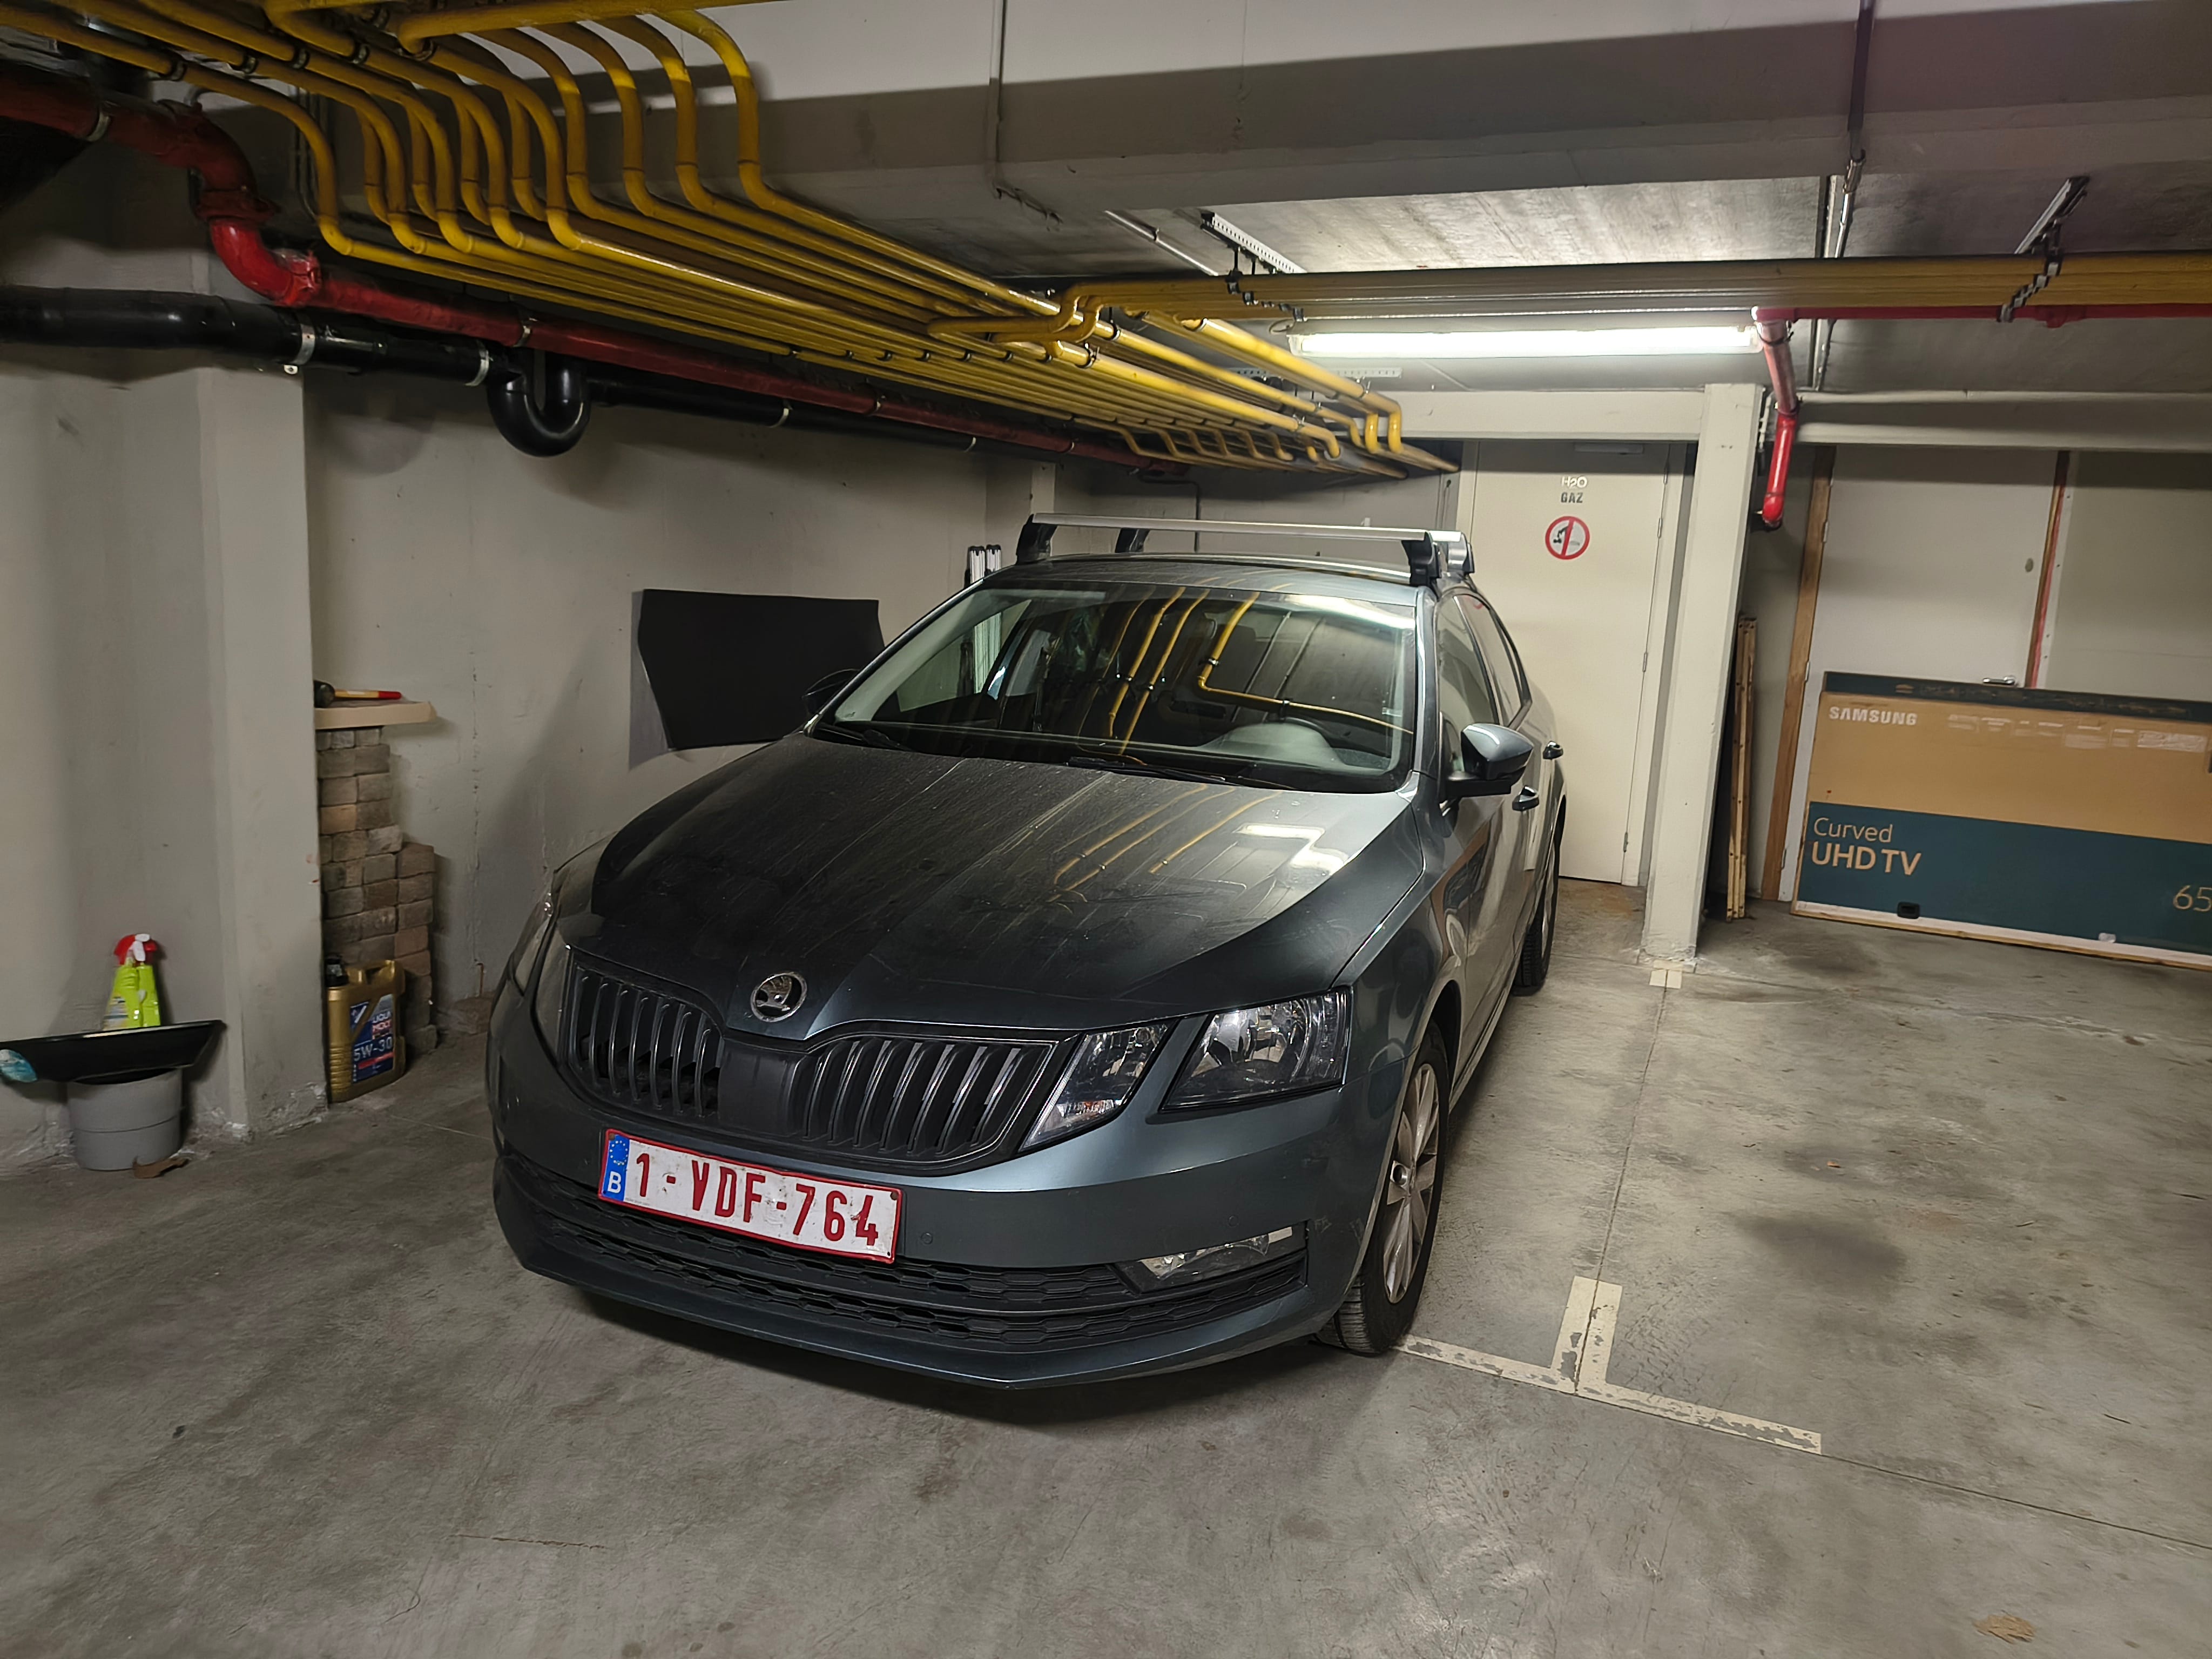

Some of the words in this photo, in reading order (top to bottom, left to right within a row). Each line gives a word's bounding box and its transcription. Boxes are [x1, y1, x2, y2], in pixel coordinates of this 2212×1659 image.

[1561, 476, 1588, 488] H2O
[1561, 492, 1583, 503] GAZ
[1829, 706, 1918, 725] SAMSUNG
[1813, 817, 1893, 843] Curved
[1812, 841, 1877, 870] UHD
[1881, 848, 1921, 875] TV
[353, 1036, 393, 1062] 5W-30
[608, 1171, 622, 1193] B
[636, 1152, 879, 1246] 1-VDF-764
